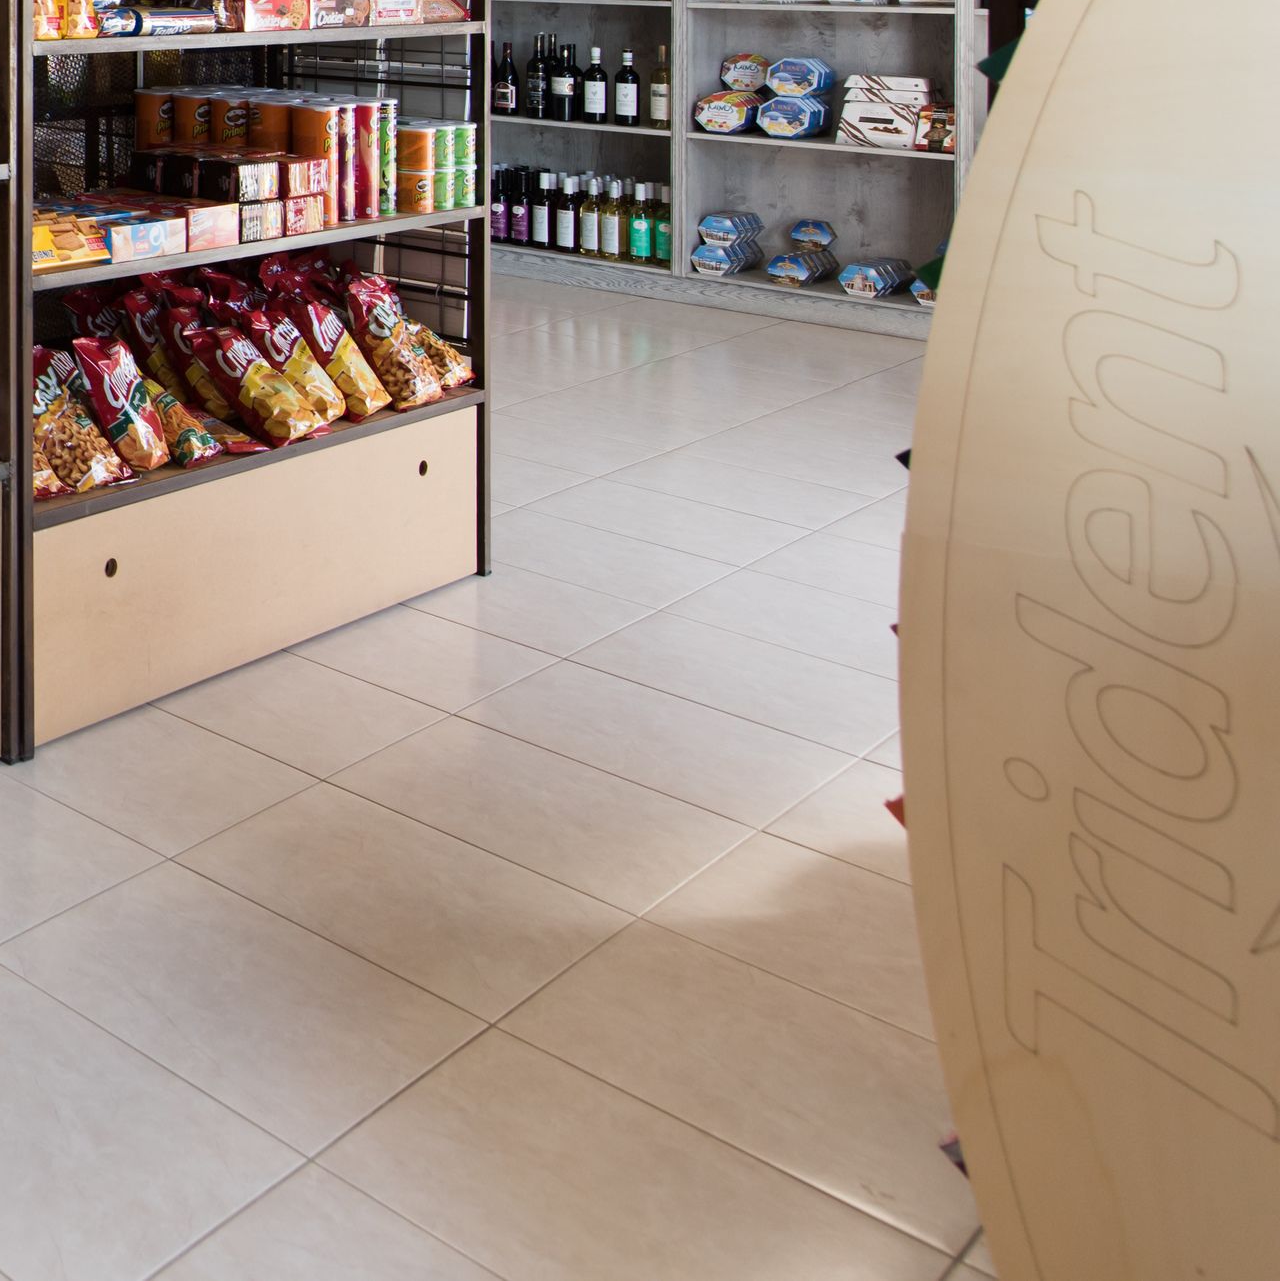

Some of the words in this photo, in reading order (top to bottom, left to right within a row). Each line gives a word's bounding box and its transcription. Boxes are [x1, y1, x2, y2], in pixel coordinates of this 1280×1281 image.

[317, 10, 345, 25] Cookies
[32, 249, 55, 263] EIBNIZ
[1004, 189, 1280, 1144] Trident
